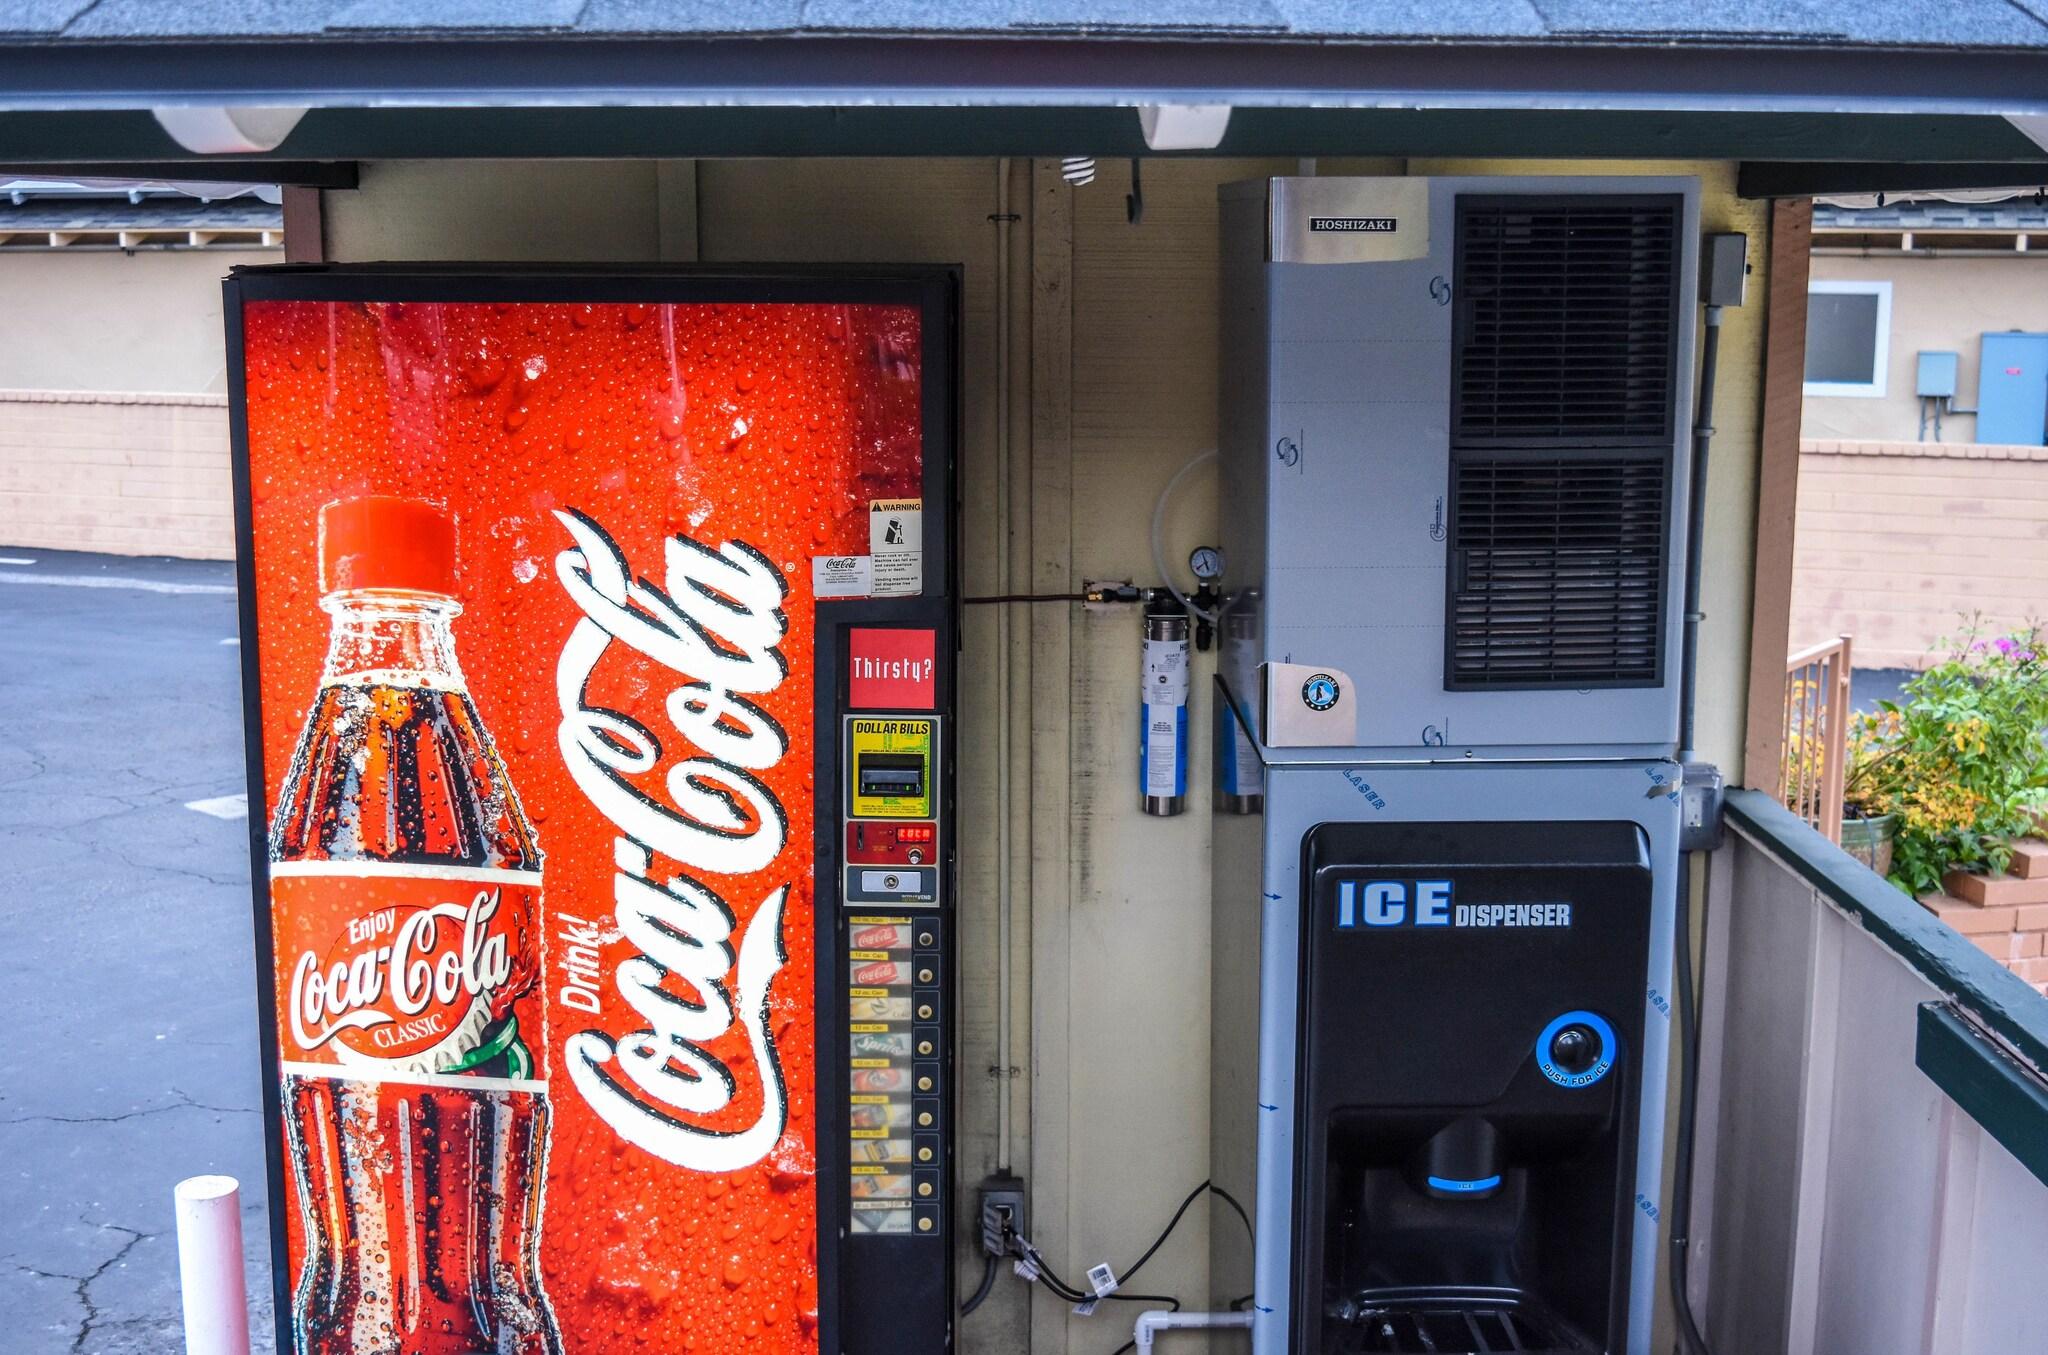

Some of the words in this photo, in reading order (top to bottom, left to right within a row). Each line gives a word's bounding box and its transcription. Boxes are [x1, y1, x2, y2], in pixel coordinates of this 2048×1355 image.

[1315, 220, 1392, 230] HOSHIZAKI
[883, 503, 921, 511] WARNING
[826, 557, 856, 569] Coca-Cola
[854, 657, 932, 682] Thirsty?
[856, 722, 897, 734] DOLLAR
[899, 723, 929, 735] BILLS
[1342, 769, 1386, 810] LASER
[551, 505, 789, 1172] Coca-Cola
[1338, 880, 1452, 928] ICE
[1455, 904, 1571, 927] DISPENSER
[349, 908, 396, 945] Enjoy
[290, 885, 511, 1050] Coca-Cola
[557, 912, 601, 1015] Drink!
[373, 1013, 447, 1049] CLASSIC
[1543, 1063, 1568, 1085] PUSH
[1571, 1074, 1593, 1086] FOR
[1594, 1061, 1609, 1077] ICE
